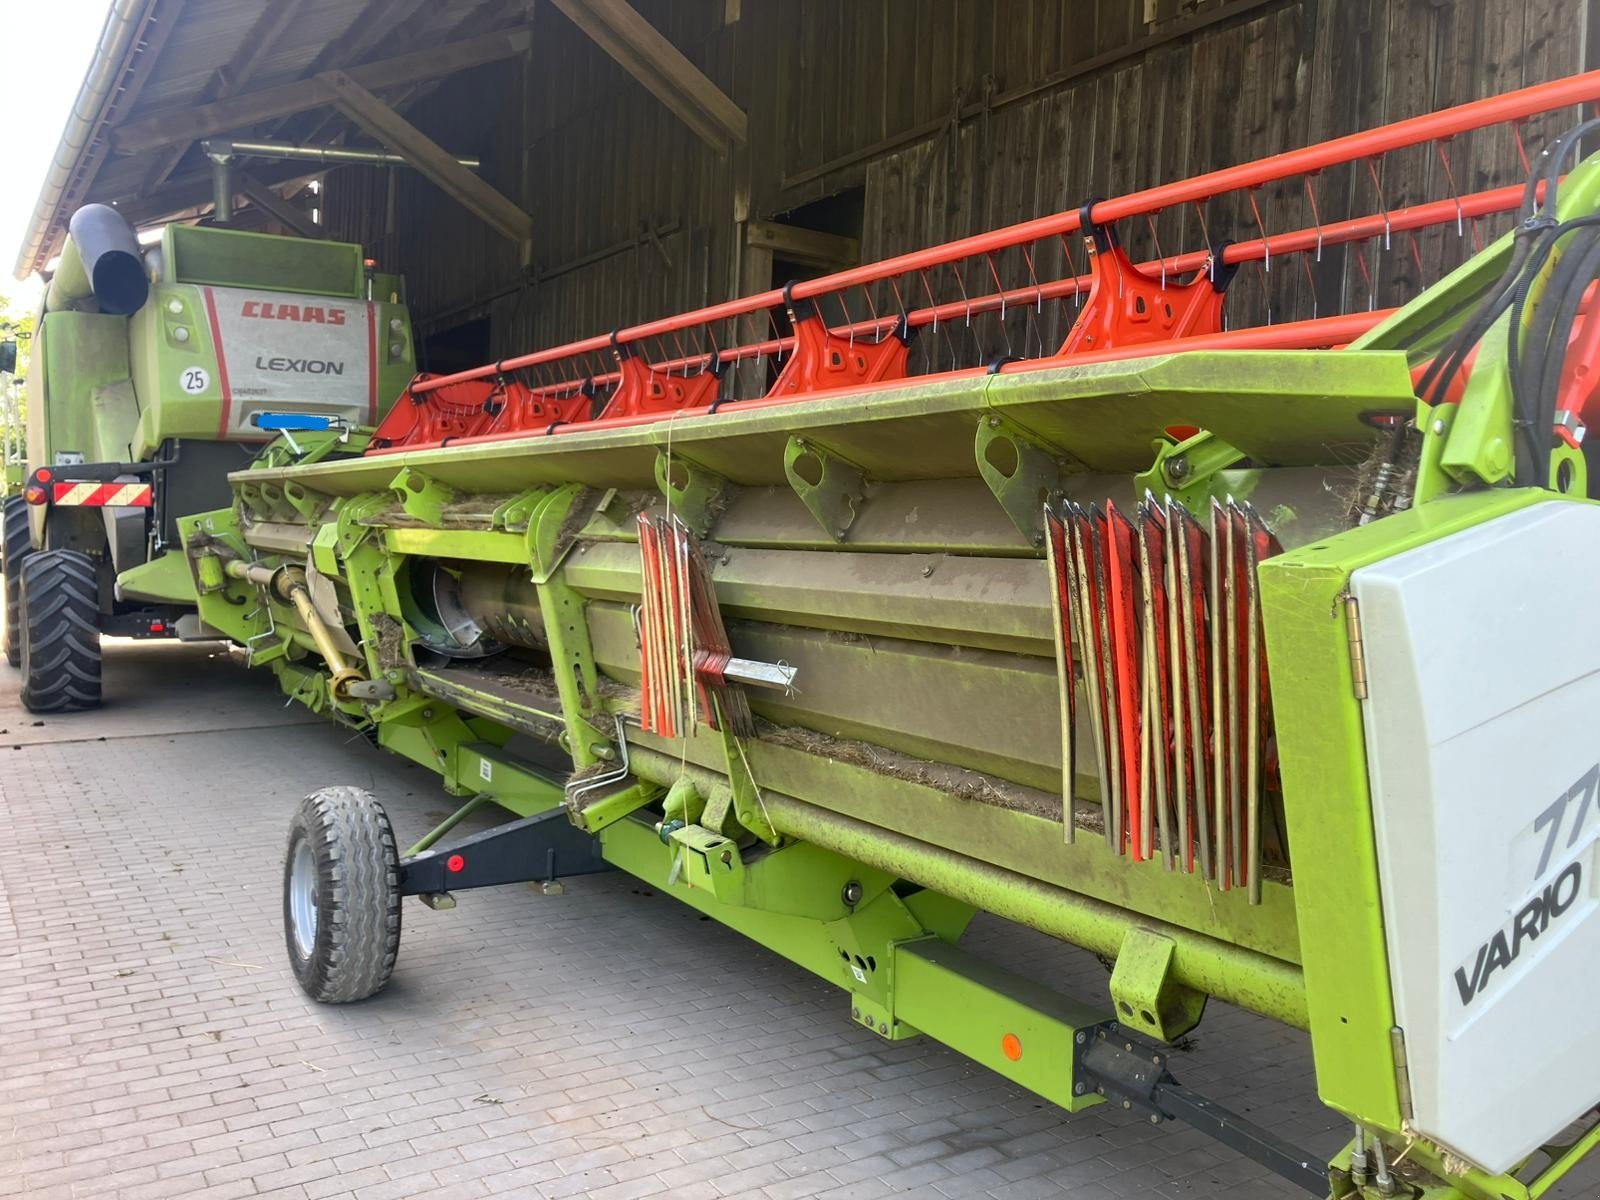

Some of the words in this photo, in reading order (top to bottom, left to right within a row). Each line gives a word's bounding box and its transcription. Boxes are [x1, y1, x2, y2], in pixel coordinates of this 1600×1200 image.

[242, 302, 345, 325] CLAAS
[256, 357, 344, 375] LEXION
[186, 371, 204, 390] 25
[1534, 763, 1600, 880] 77
[1454, 861, 1582, 1006] VARIO
